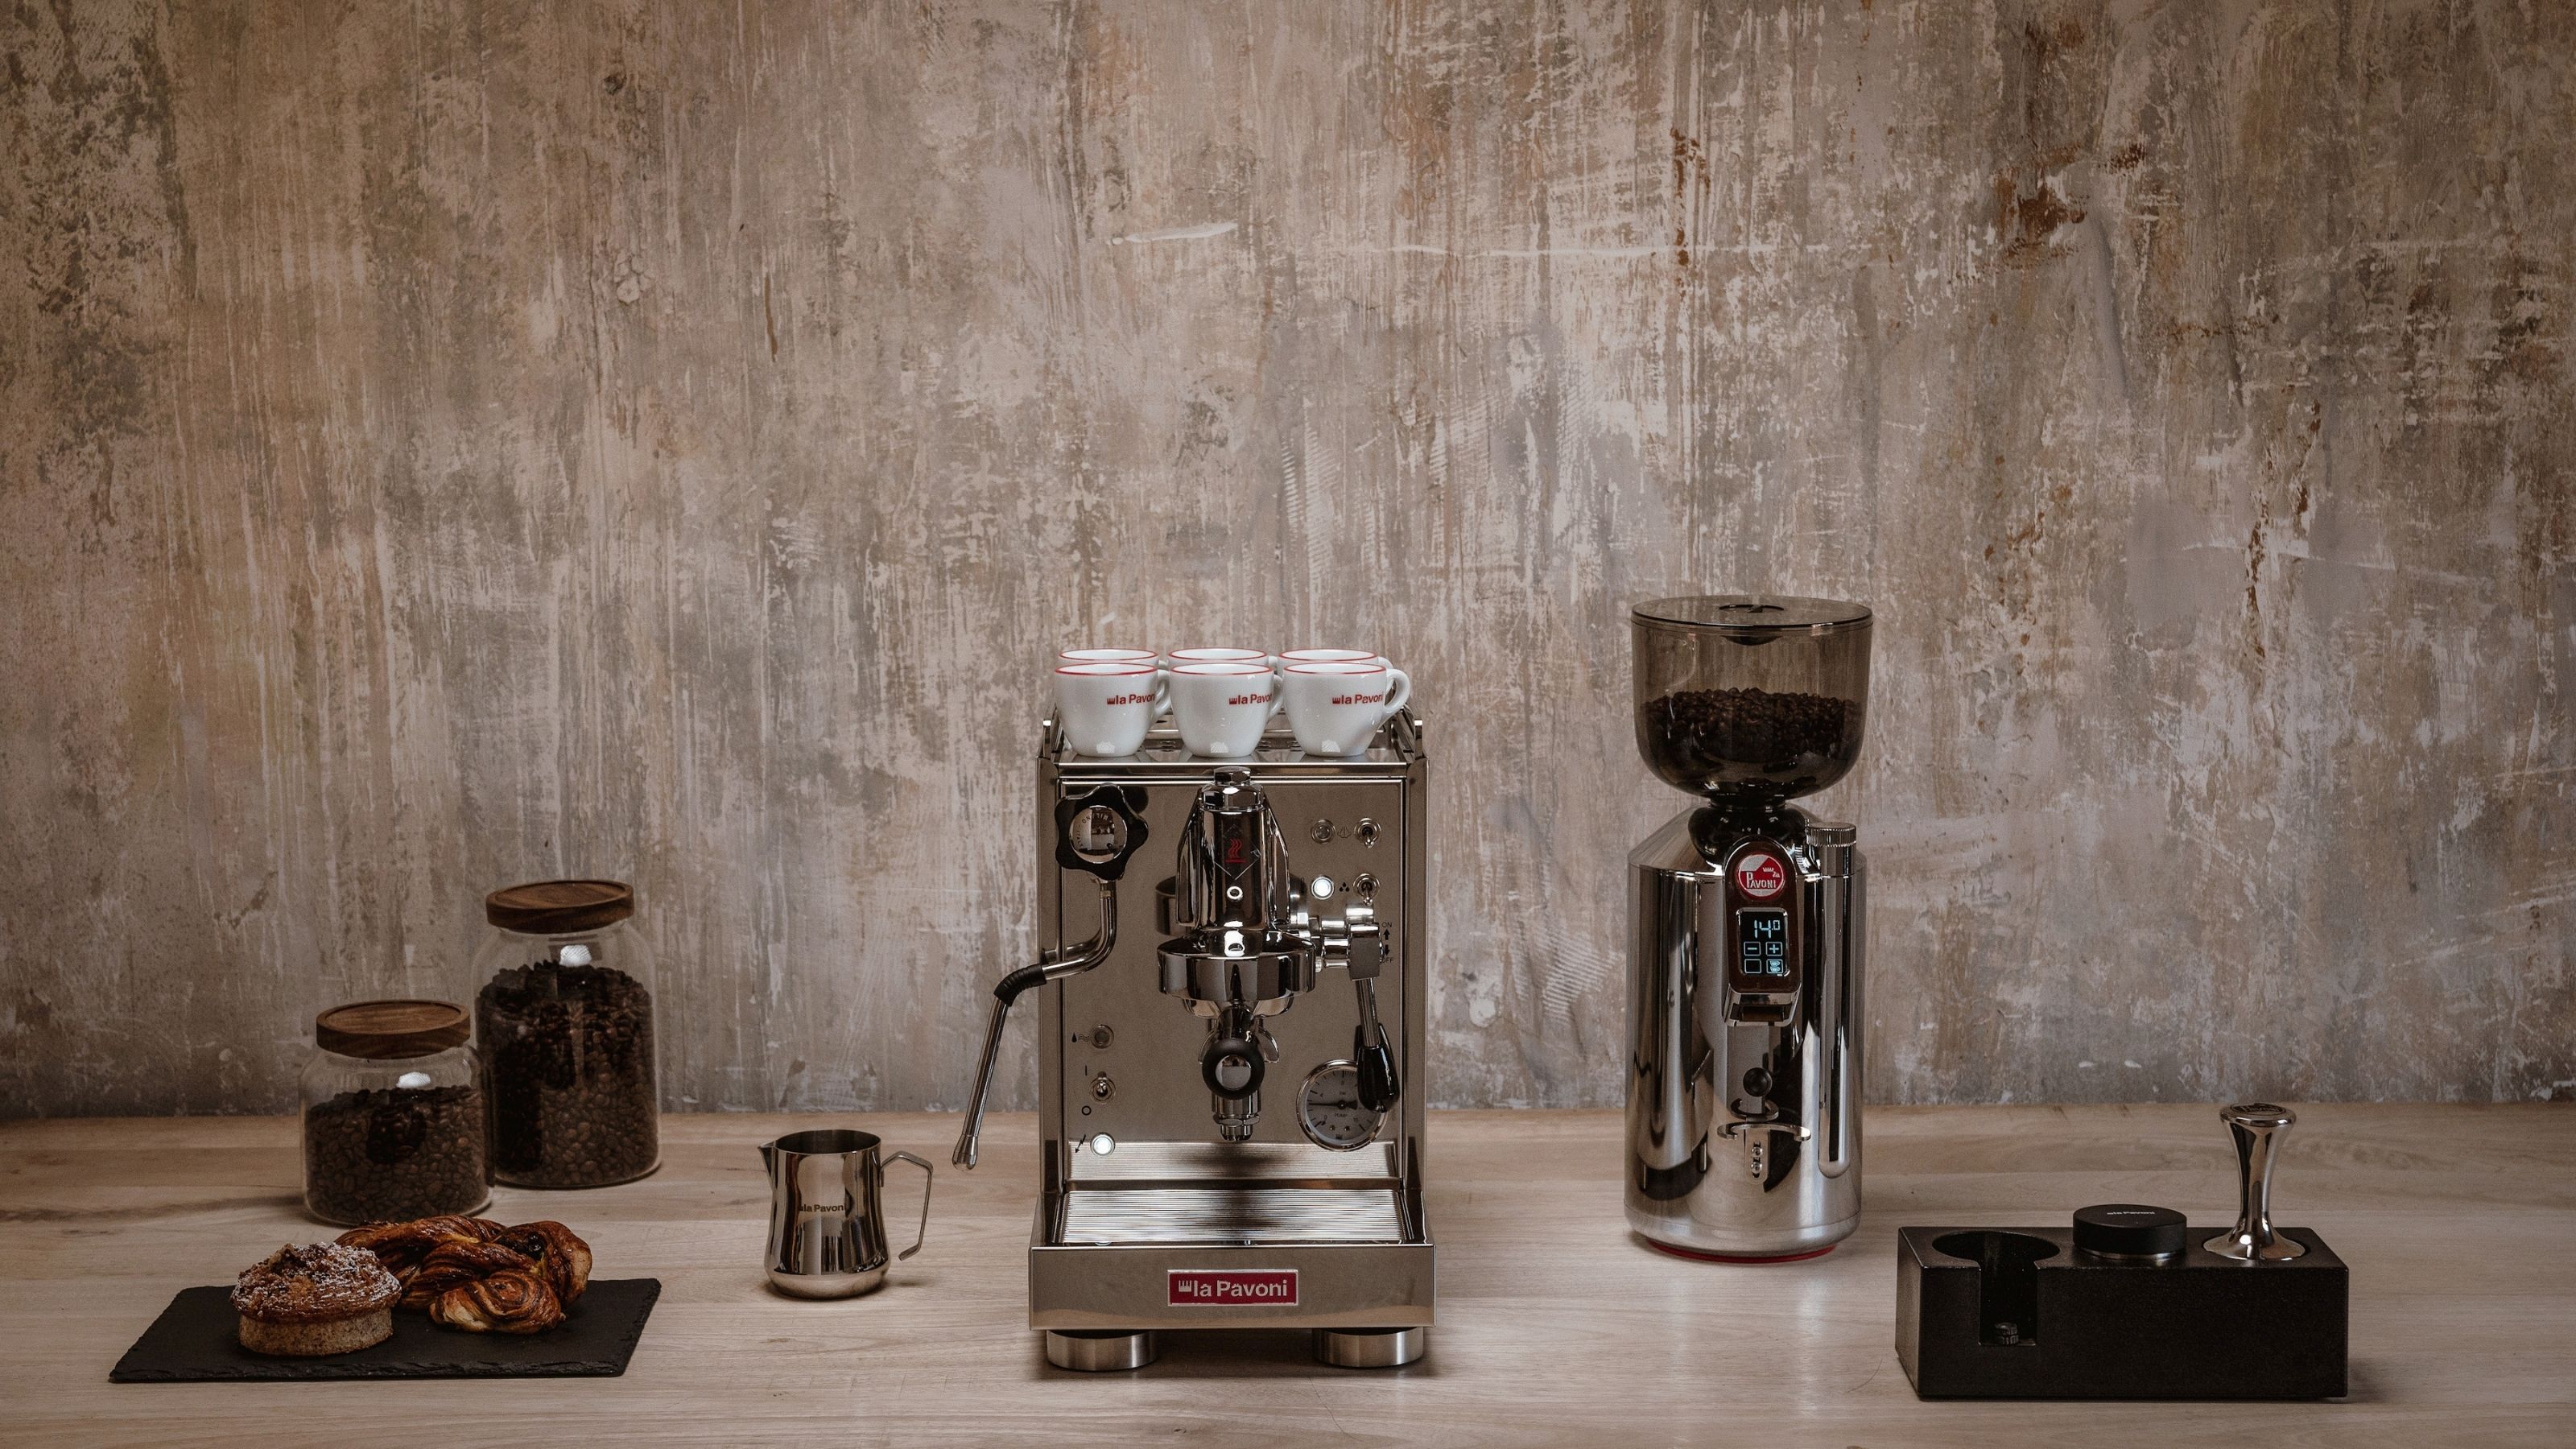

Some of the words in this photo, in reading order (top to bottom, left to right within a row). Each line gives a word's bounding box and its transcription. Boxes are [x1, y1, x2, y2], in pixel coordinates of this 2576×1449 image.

[1116, 695, 1126, 704] la
[1129, 694, 1155, 704] Pavon
[1238, 695, 1248, 704] la
[1341, 695, 1352, 704] la
[1194, 1280, 1212, 1297] la
[1216, 1279, 1288, 1297] Pavoni
